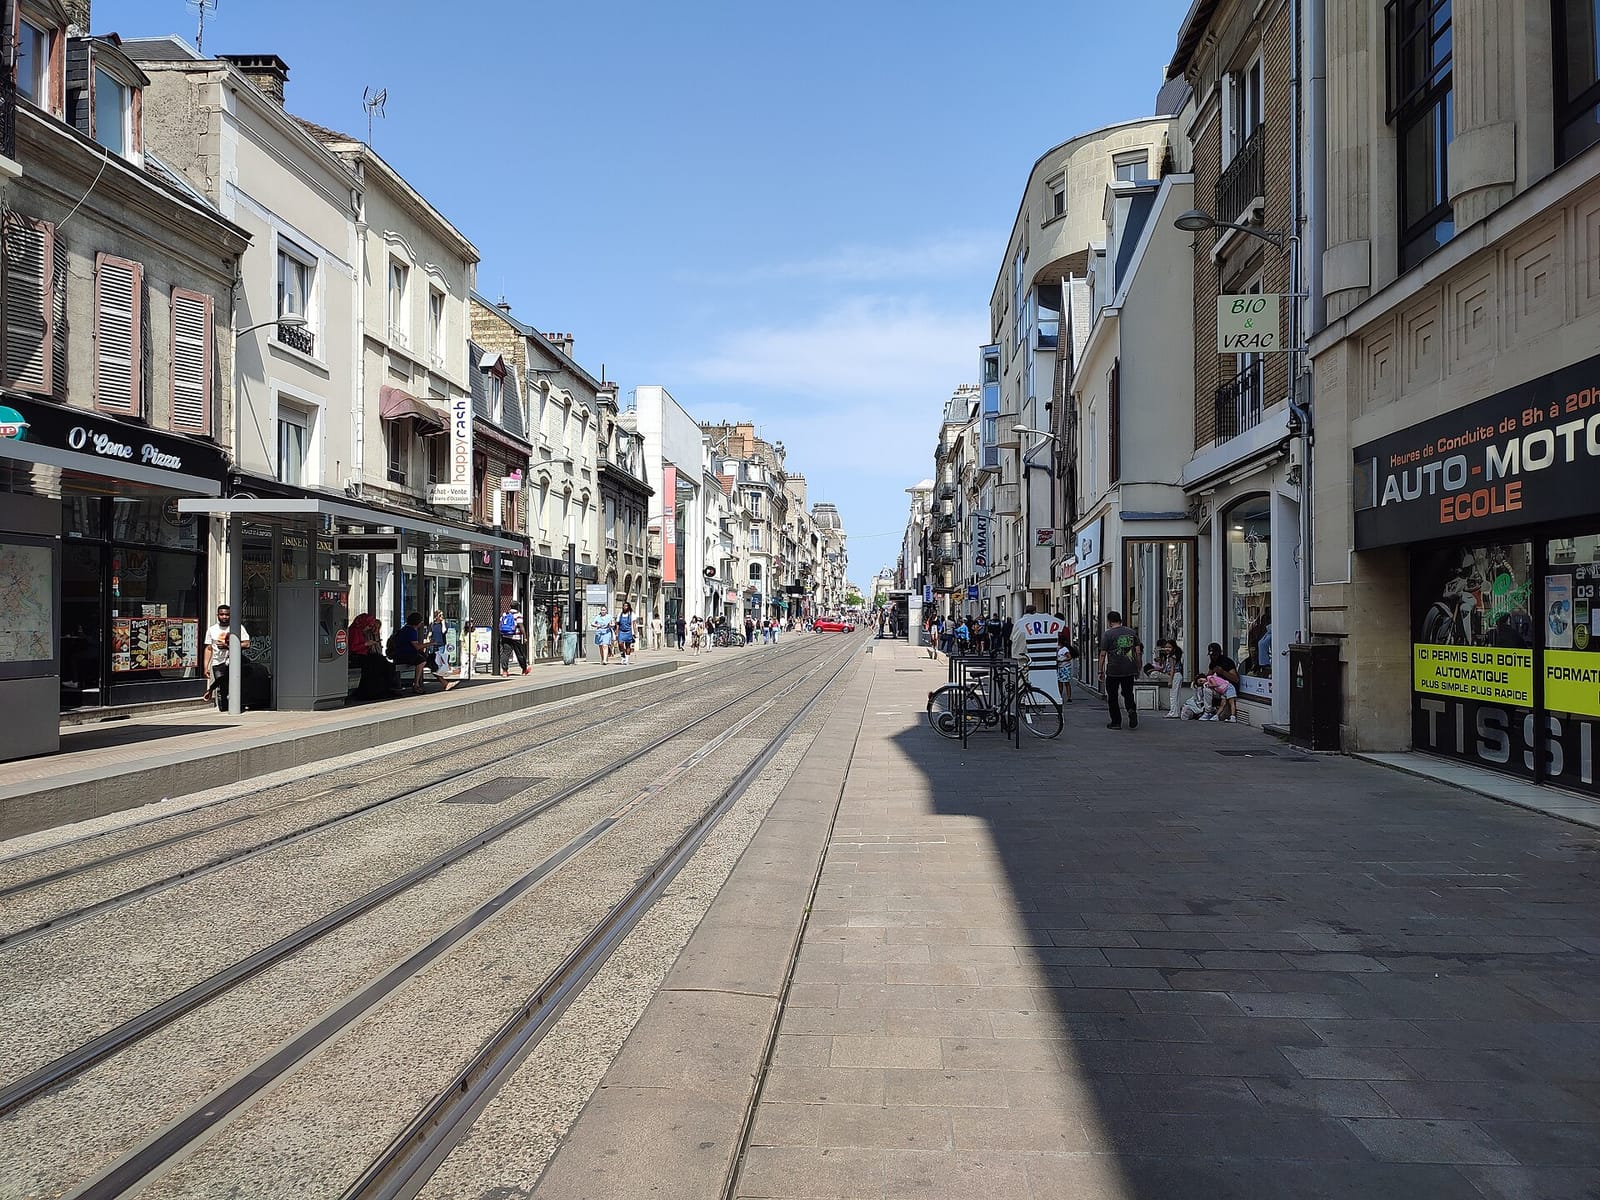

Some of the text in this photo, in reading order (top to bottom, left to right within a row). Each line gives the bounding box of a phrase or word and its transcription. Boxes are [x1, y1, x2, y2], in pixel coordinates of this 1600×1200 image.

[1231, 298, 1266, 314] BIO
[1244, 318, 1254, 328] &
[1224, 333, 1274, 348] VRAC
[453, 401, 468, 482] happycash
[1390, 449, 1420, 467] Heures
[1423, 444, 1434, 457] de
[1437, 427, 1494, 453] Conduite
[1499, 417, 1517, 434] de
[1522, 407, 1543, 427] 8h
[1549, 402, 1559, 418] à
[141, 443, 182, 469] Pizza
[1440, 481, 1522, 523] ECOLE
[976, 515, 987, 567] DAMART
[1577, 585, 1594, 598] 03
[1025, 621, 1060, 636] FRIP
[1418, 649, 1531, 668] ICI PERMIS SUR BOÎTE
[1435, 666, 1509, 684] AUTOMATIQUE
[1421, 679, 1528, 701] PLUS SIMPLE PLUS RAPIDE
